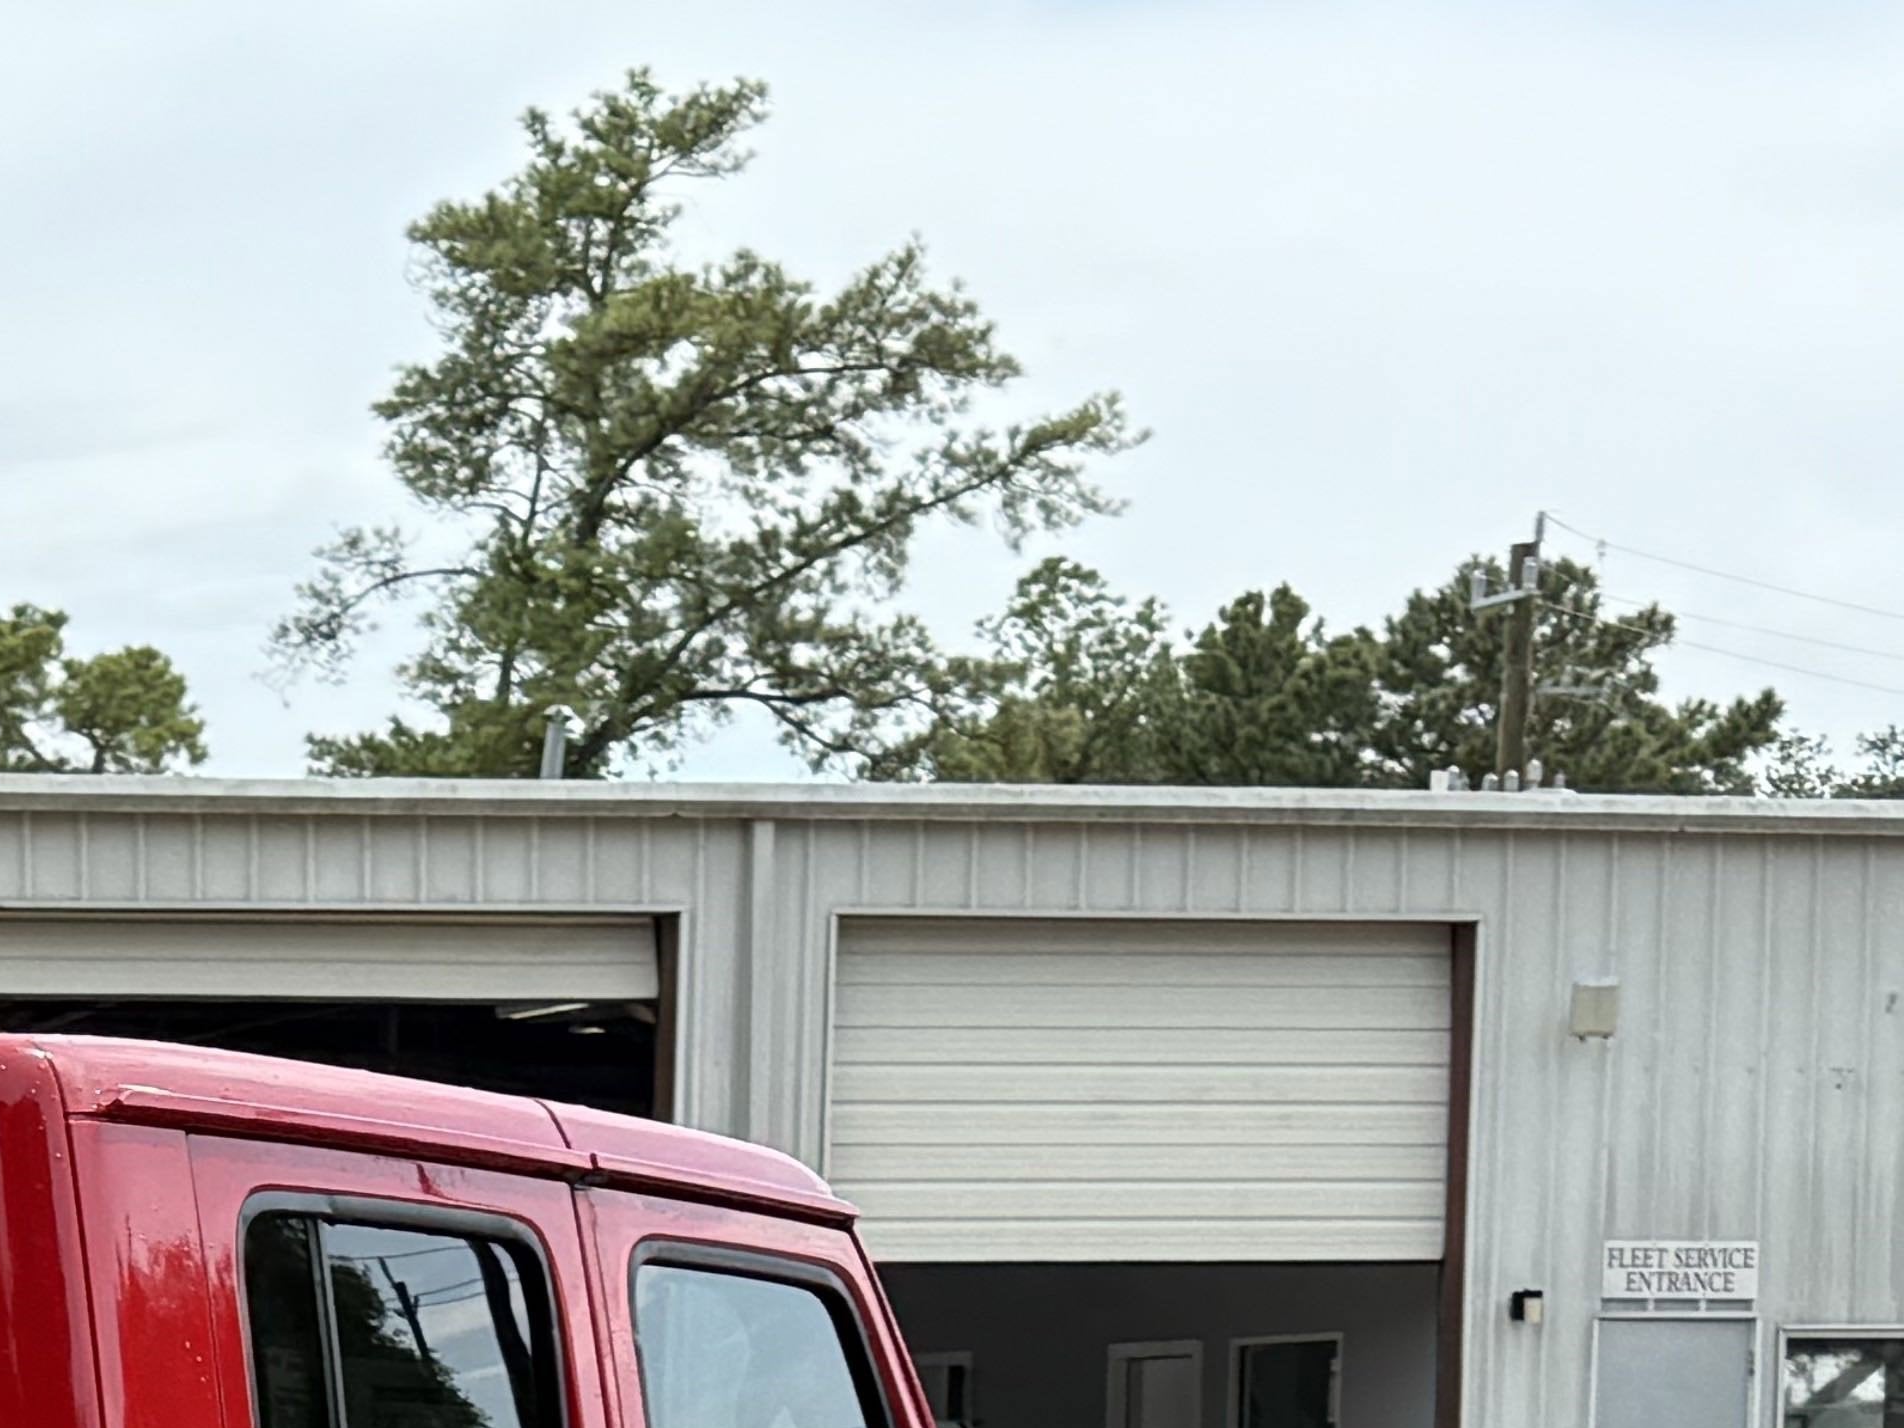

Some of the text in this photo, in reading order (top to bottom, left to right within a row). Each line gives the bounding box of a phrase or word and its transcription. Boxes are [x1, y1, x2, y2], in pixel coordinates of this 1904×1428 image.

[1607, 1246, 1756, 1270] FLEET SERVICE
[1625, 1270, 1735, 1293] ENTRANCE
